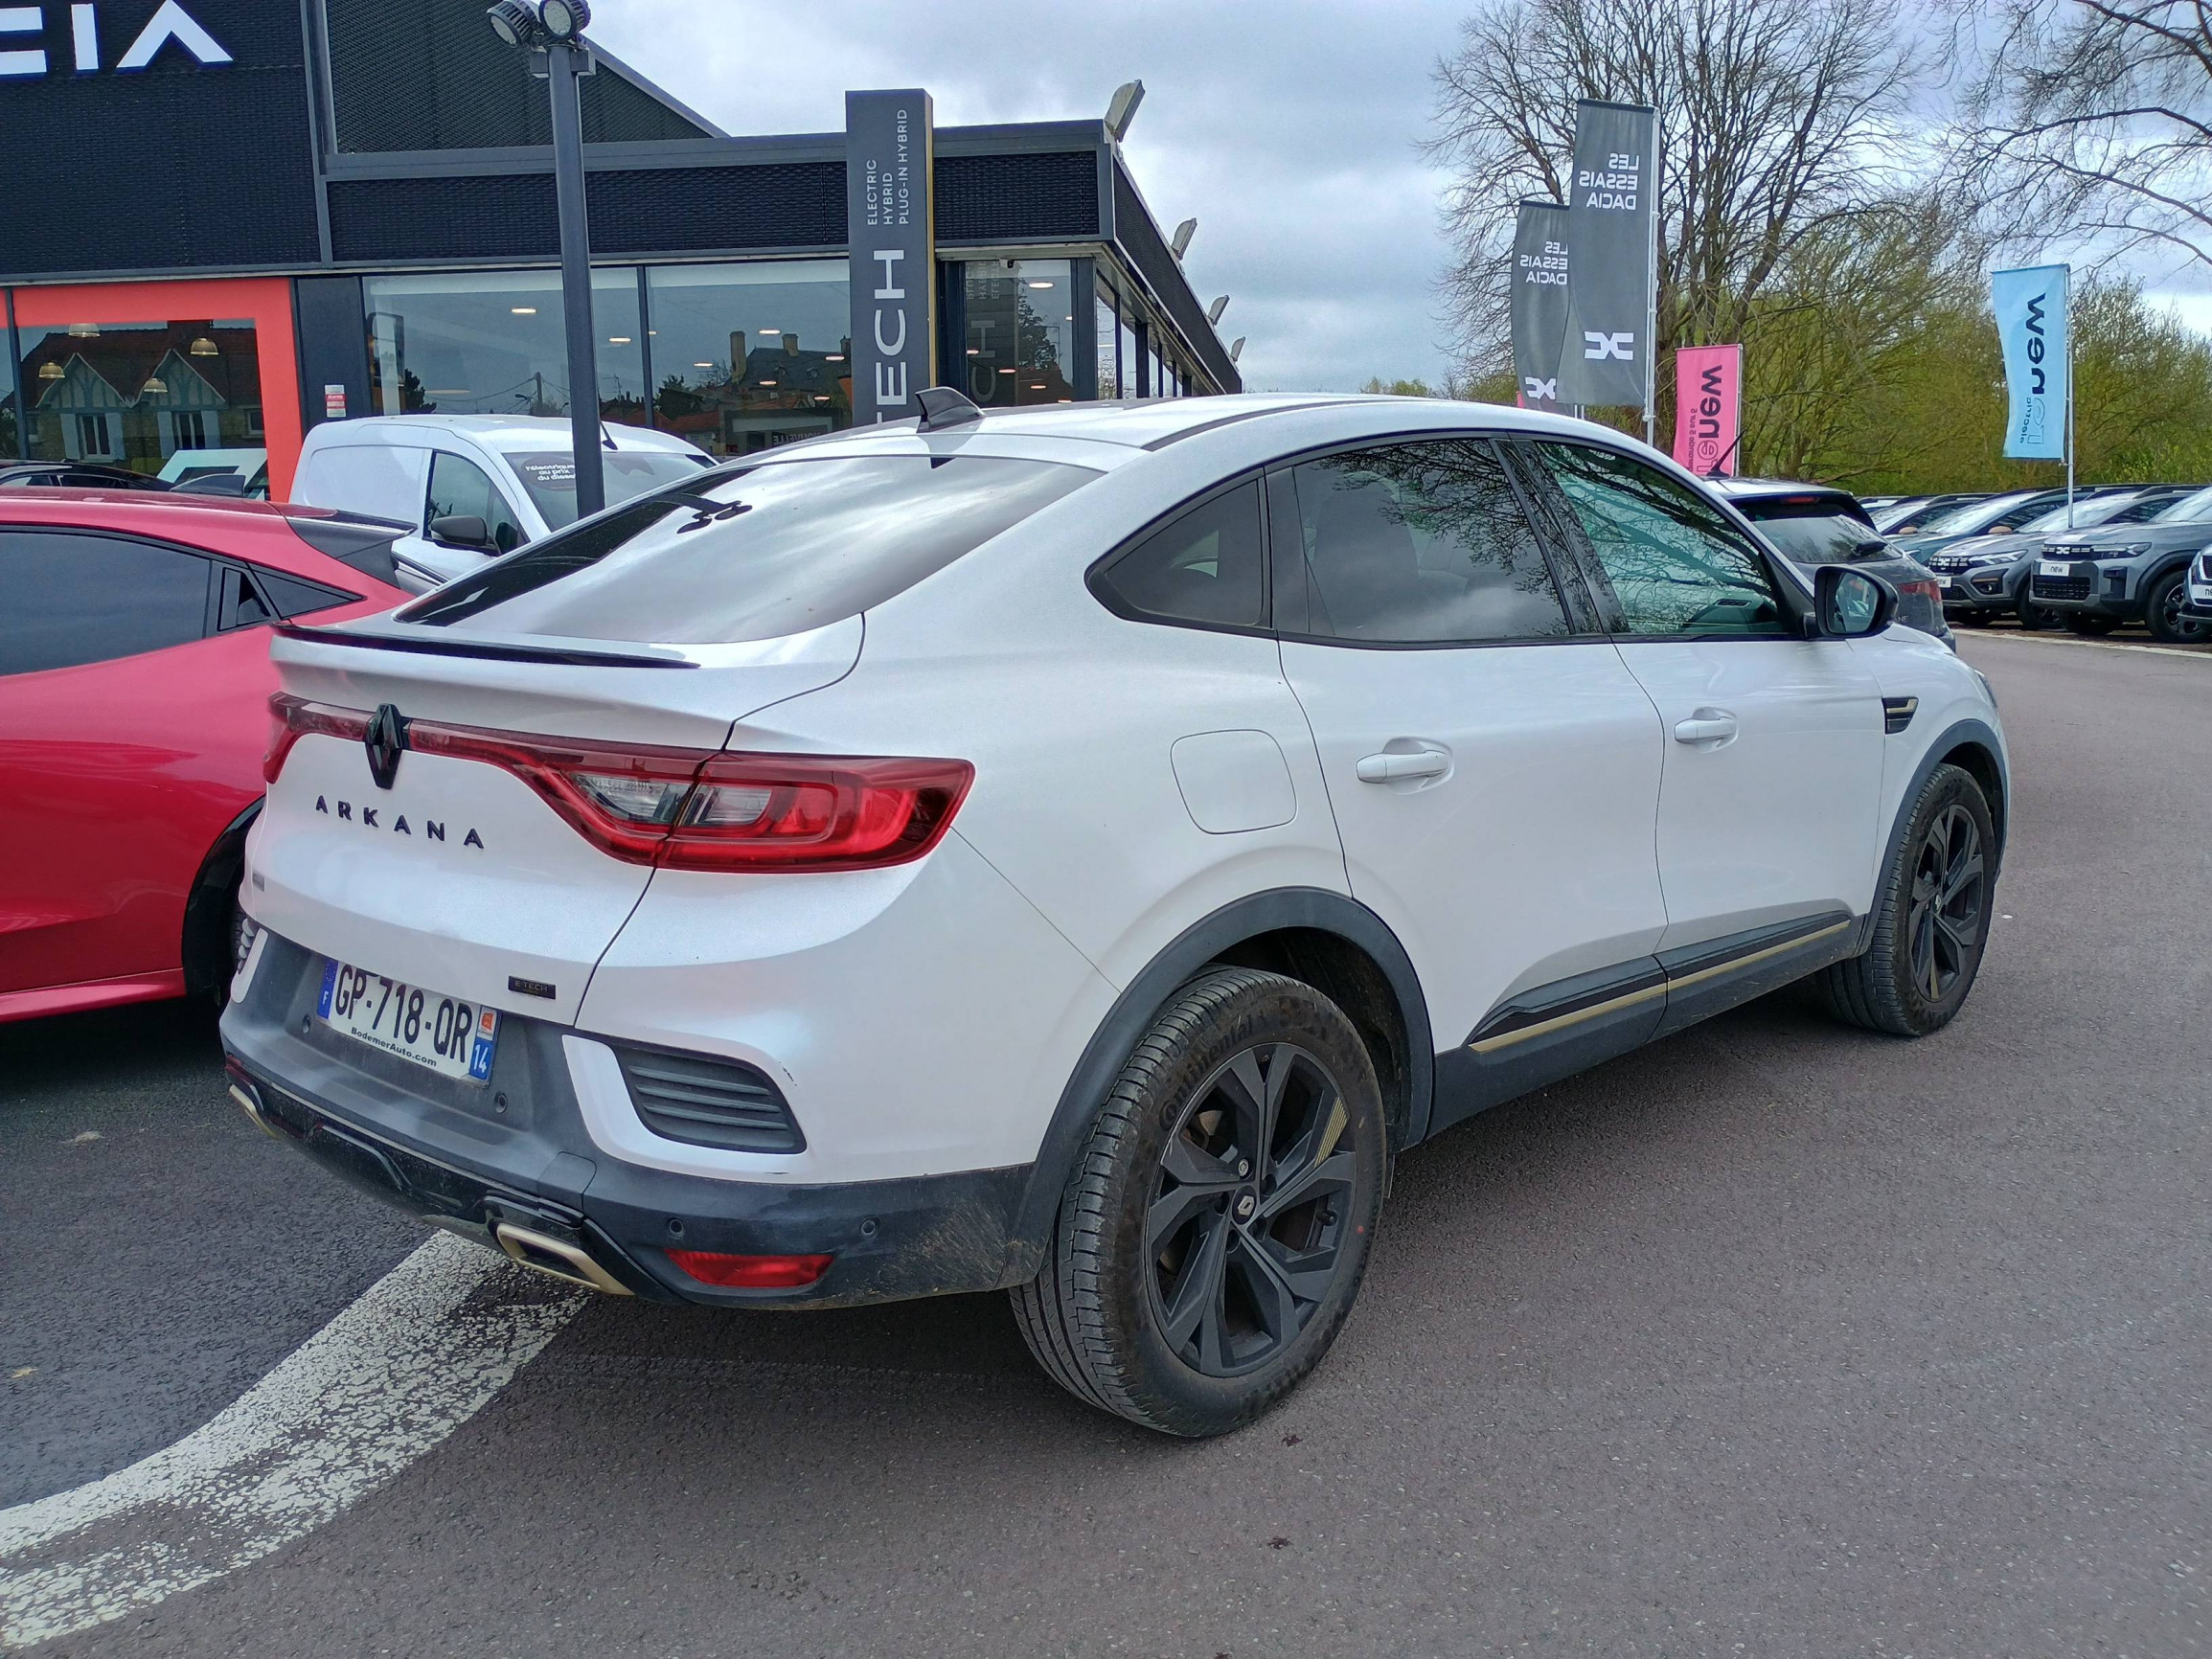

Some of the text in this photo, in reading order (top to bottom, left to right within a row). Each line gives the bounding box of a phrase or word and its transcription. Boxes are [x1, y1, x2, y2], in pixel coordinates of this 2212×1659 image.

[866, 159, 878, 226] ELECTRIC
[897, 109, 909, 225] PLUG-IN HYBRID
[882, 172, 894, 225] HYBRID
[2050, 565, 2064, 574] new
[315, 795, 485, 850] ARKANA
[322, 990, 330, 1006] F
[335, 964, 473, 1063] GP-718-QR
[351, 1027, 437, 1067] BodemerAuto.com
[474, 1043, 488, 1074] 14
